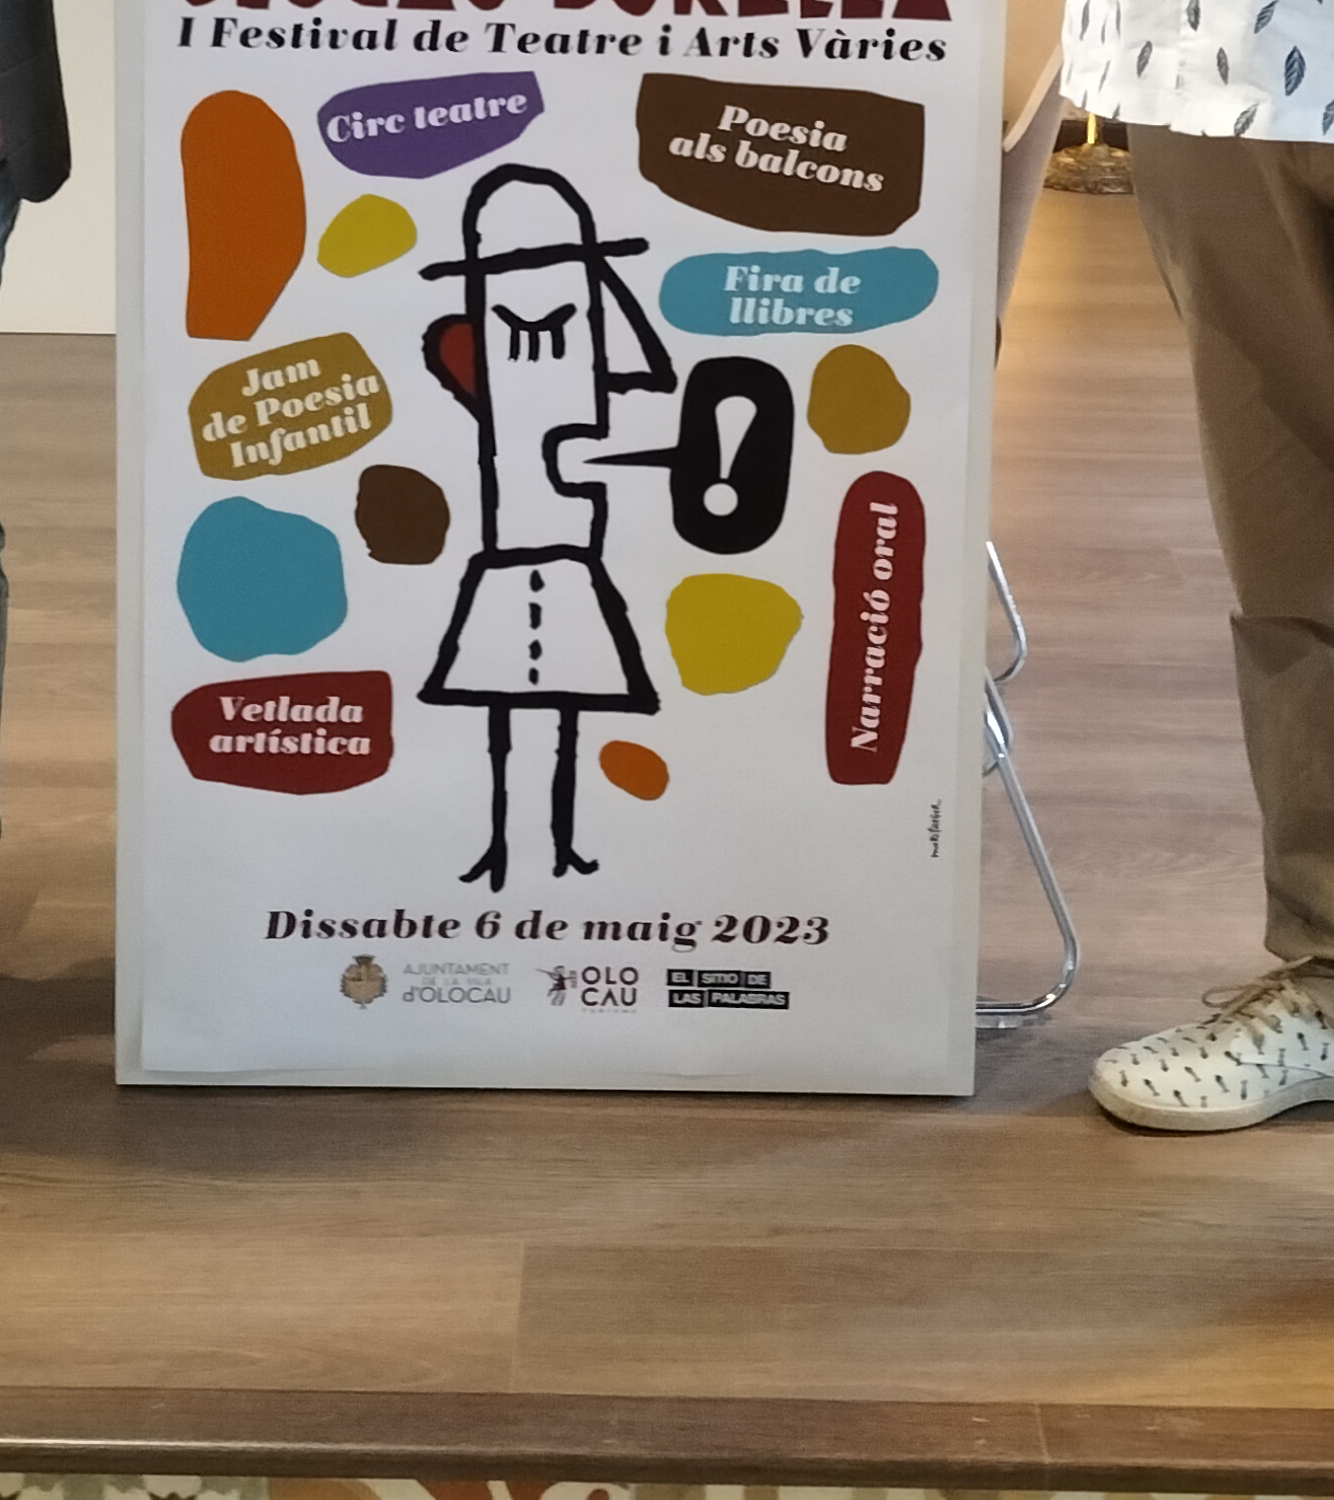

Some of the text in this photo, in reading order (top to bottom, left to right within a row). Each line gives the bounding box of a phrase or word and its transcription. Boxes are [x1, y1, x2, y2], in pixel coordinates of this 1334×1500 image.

[177, 16, 947, 61] I Festival de Teatre i Arts Vàries
[326, 93, 528, 142] Circ teatre
[718, 105, 848, 151] Poesia
[669, 133, 884, 192] als balcons
[723, 265, 861, 294] Fira de
[729, 297, 854, 327] llibres
[241, 359, 322, 397] Jam
[202, 373, 380, 442] de Poesia
[230, 403, 372, 468] Infantil
[851, 502, 899, 753] Narració oral
[219, 696, 364, 723] Vetlada
[209, 727, 370, 755] artística
[265, 909, 830, 953] Dissabte 6 de maig 2023
[403, 963, 511, 976] AJUNTAMENT
[581, 966, 639, 985] OLO
[671, 972, 689, 983] EL
[747, 974, 767, 986] DE
[402, 985, 511, 1004] d'OLOCAU
[581, 987, 637, 1006] CAU
[673, 992, 786, 1006] LAS PALABRAS
